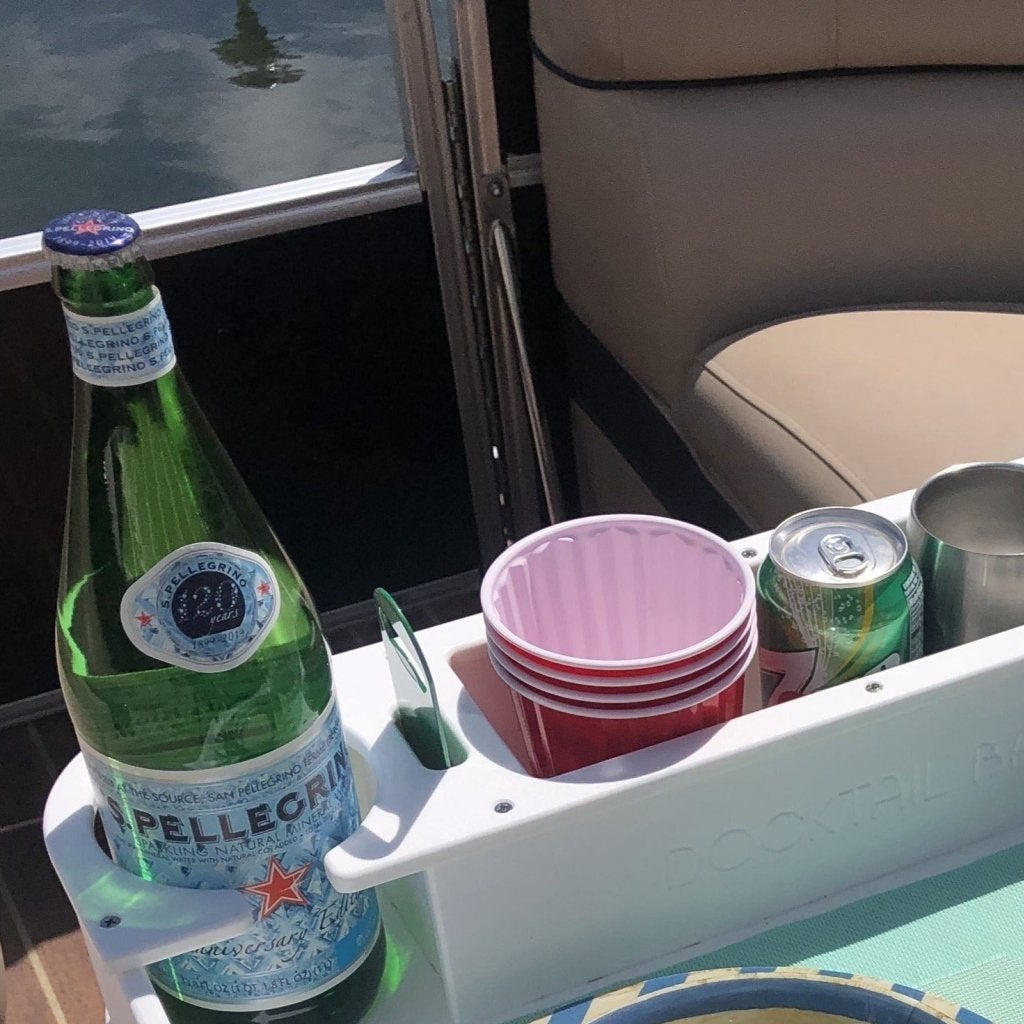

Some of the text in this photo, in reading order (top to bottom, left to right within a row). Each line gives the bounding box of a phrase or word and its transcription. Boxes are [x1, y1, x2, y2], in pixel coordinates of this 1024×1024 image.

[162, 561, 247, 609] S.PELLEGRINO
[209, 608, 239, 636] years
[207, 790, 235, 803] SAN
[237, 764, 302, 798] PELLEGRINO
[215, 832, 281, 856] NATURAL
